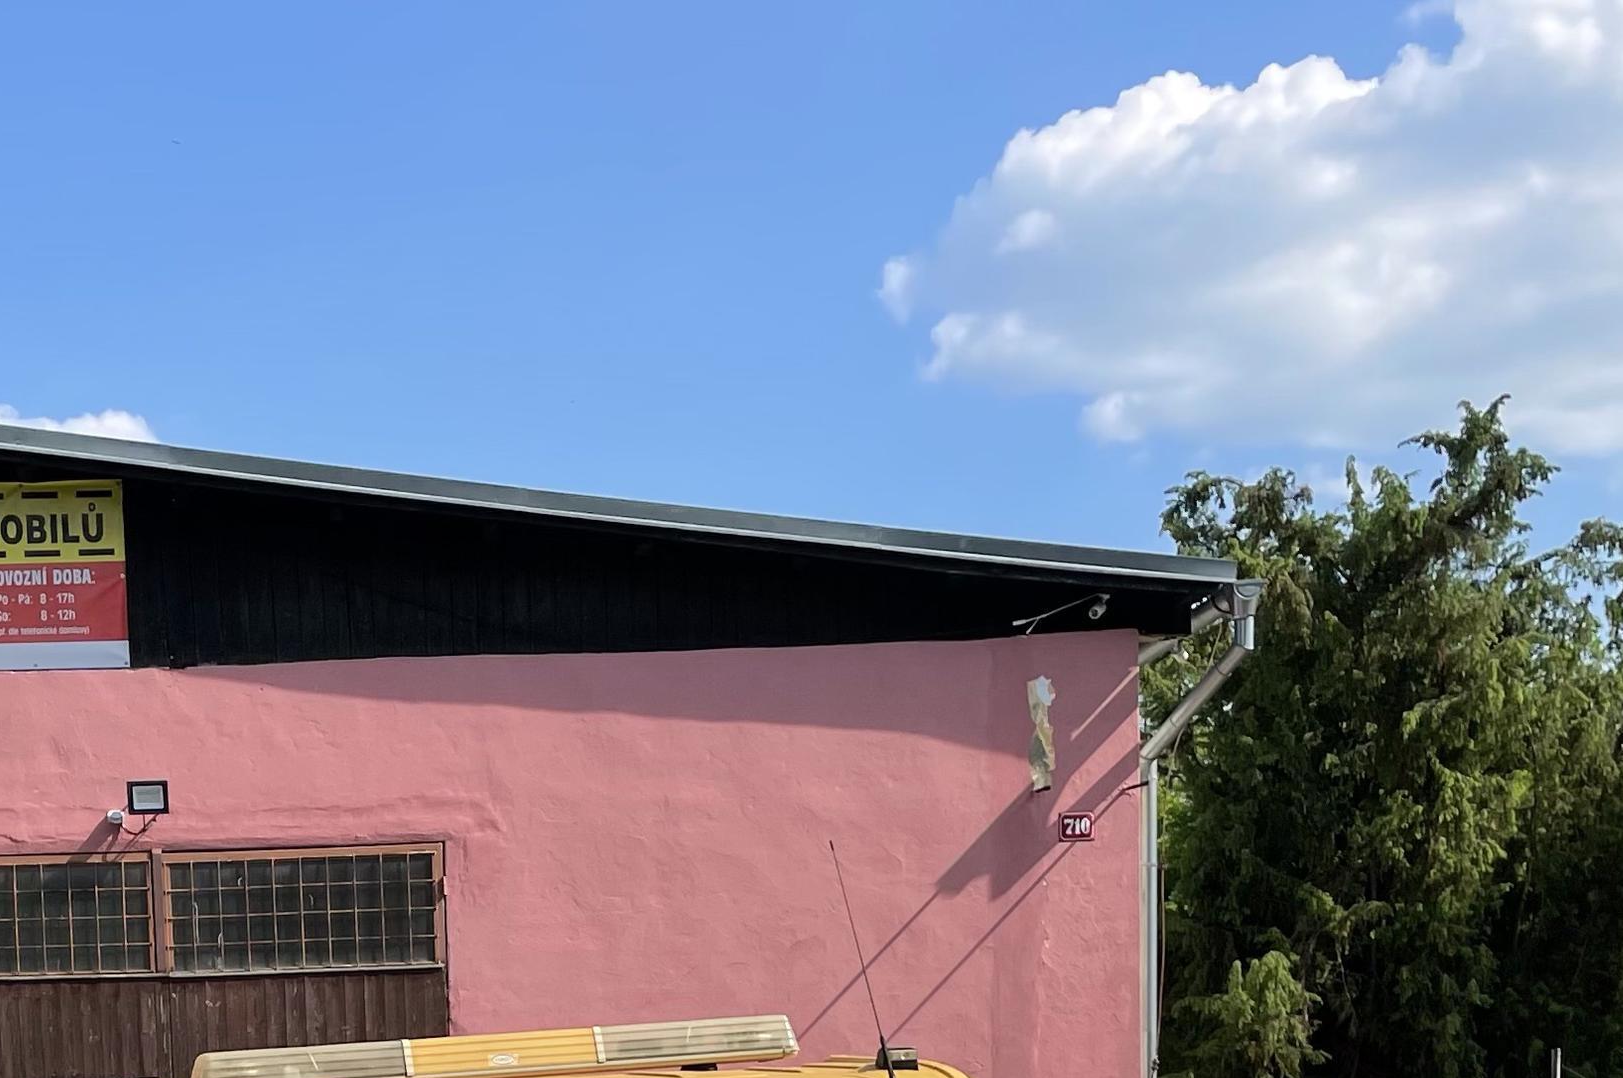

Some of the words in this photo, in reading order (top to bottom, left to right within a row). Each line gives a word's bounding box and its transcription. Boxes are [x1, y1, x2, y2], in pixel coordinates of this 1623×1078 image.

[53, 568, 96, 585] DOBA:
[39, 593, 47, 604] 8
[56, 592, 75, 604] 17h
[40, 610, 48, 621] 8
[57, 609, 76, 621] 12h
[1063, 817, 1091, 835] 710
